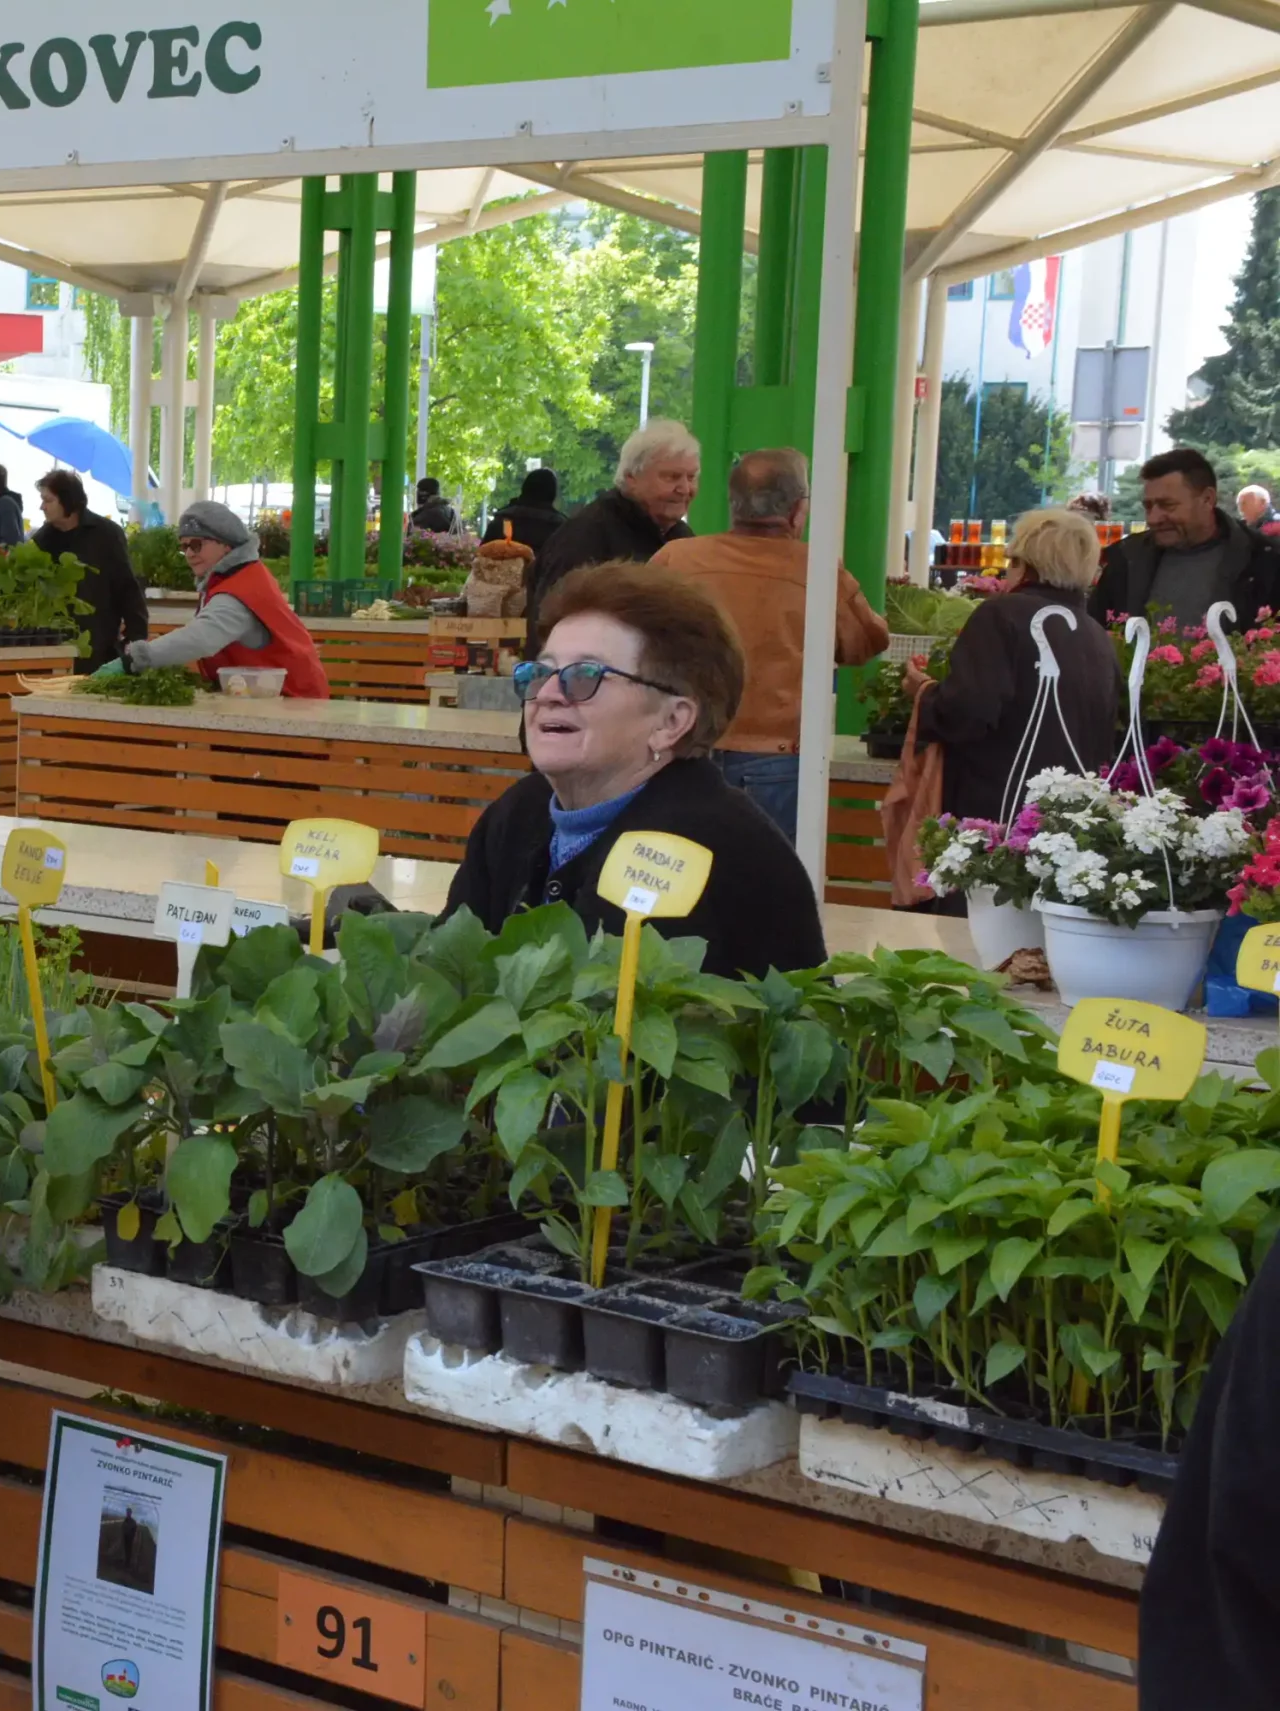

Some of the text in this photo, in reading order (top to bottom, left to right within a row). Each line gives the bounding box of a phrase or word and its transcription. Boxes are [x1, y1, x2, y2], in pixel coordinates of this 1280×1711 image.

[623, 864, 672, 893] PAPRIKA
[234, 906, 262, 920] RVENO
[1104, 1008, 1151, 1038] ŽUTA
[1081, 1037, 1161, 1071] BABURA
[96, 1459, 132, 1476] ZVONKO
[132, 1469, 174, 1489] PINTARIĆ
[316, 1605, 379, 1673] 91
[603, 1628, 635, 1648] OPG
[639, 1638, 715, 1671] PINTARIĆ
[728, 1663, 800, 1694] ZVONKO
